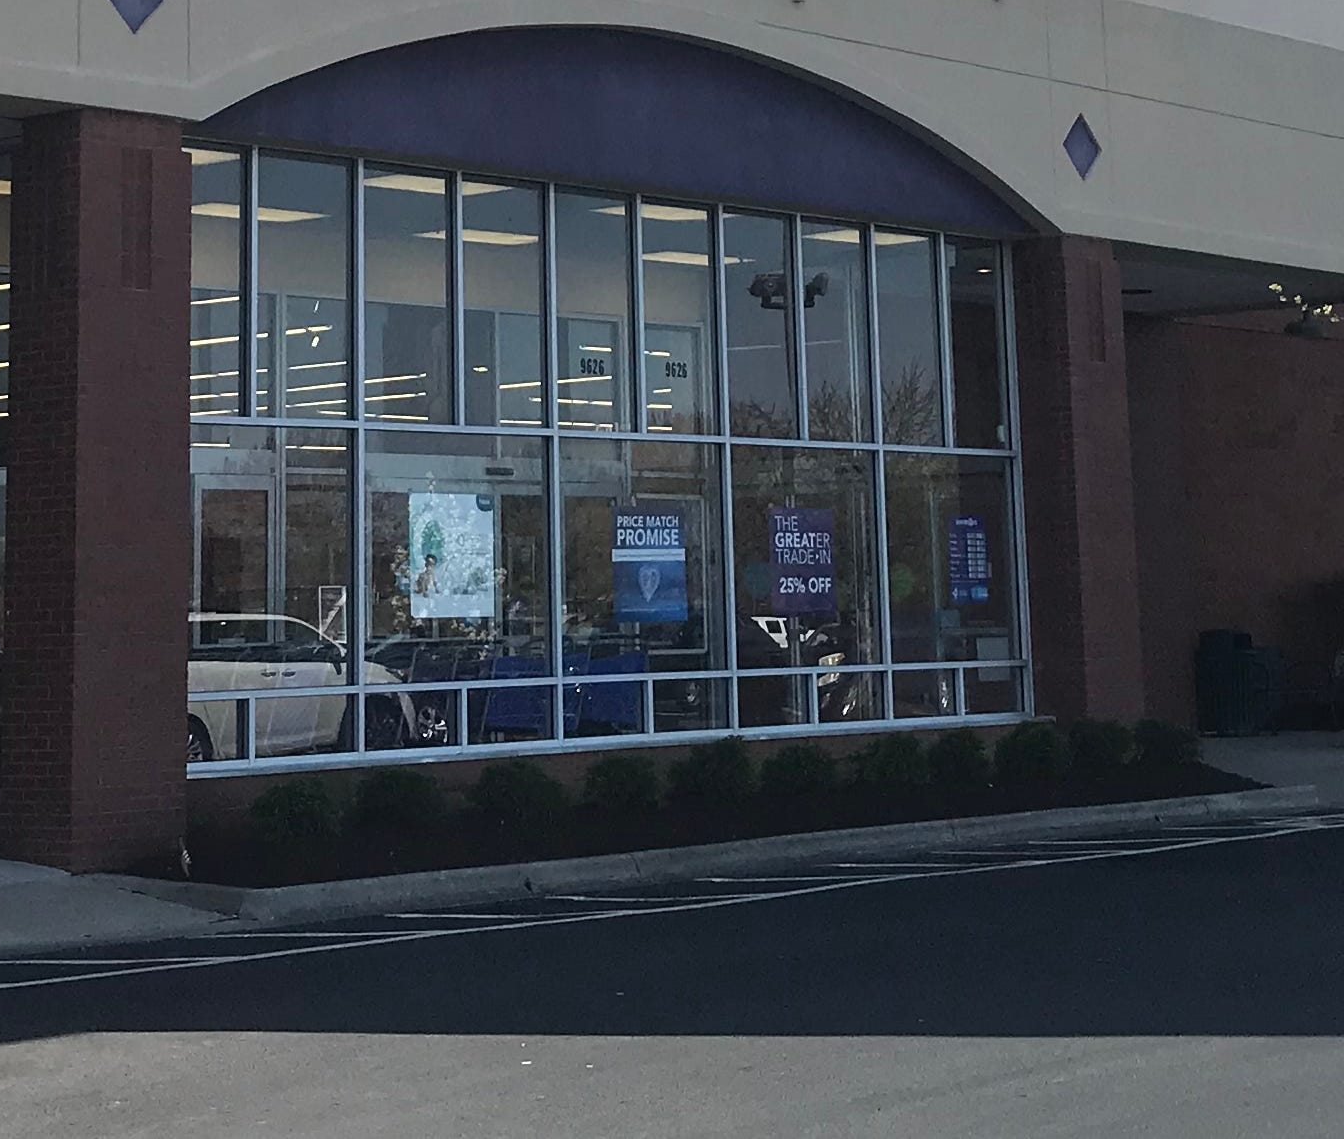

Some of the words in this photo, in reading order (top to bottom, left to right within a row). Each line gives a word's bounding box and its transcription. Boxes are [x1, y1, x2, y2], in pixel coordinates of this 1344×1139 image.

[580, 358, 605, 375] 9626
[665, 362, 688, 378] 9626
[617, 516, 644, 527] PRICE
[645, 515, 680, 527] MATCH
[775, 516, 798, 531] THE
[617, 529, 680, 546] PROMISE
[775, 532, 831, 548] GREATER
[779, 577, 806, 594] 25%
[808, 577, 832, 593] OFF
